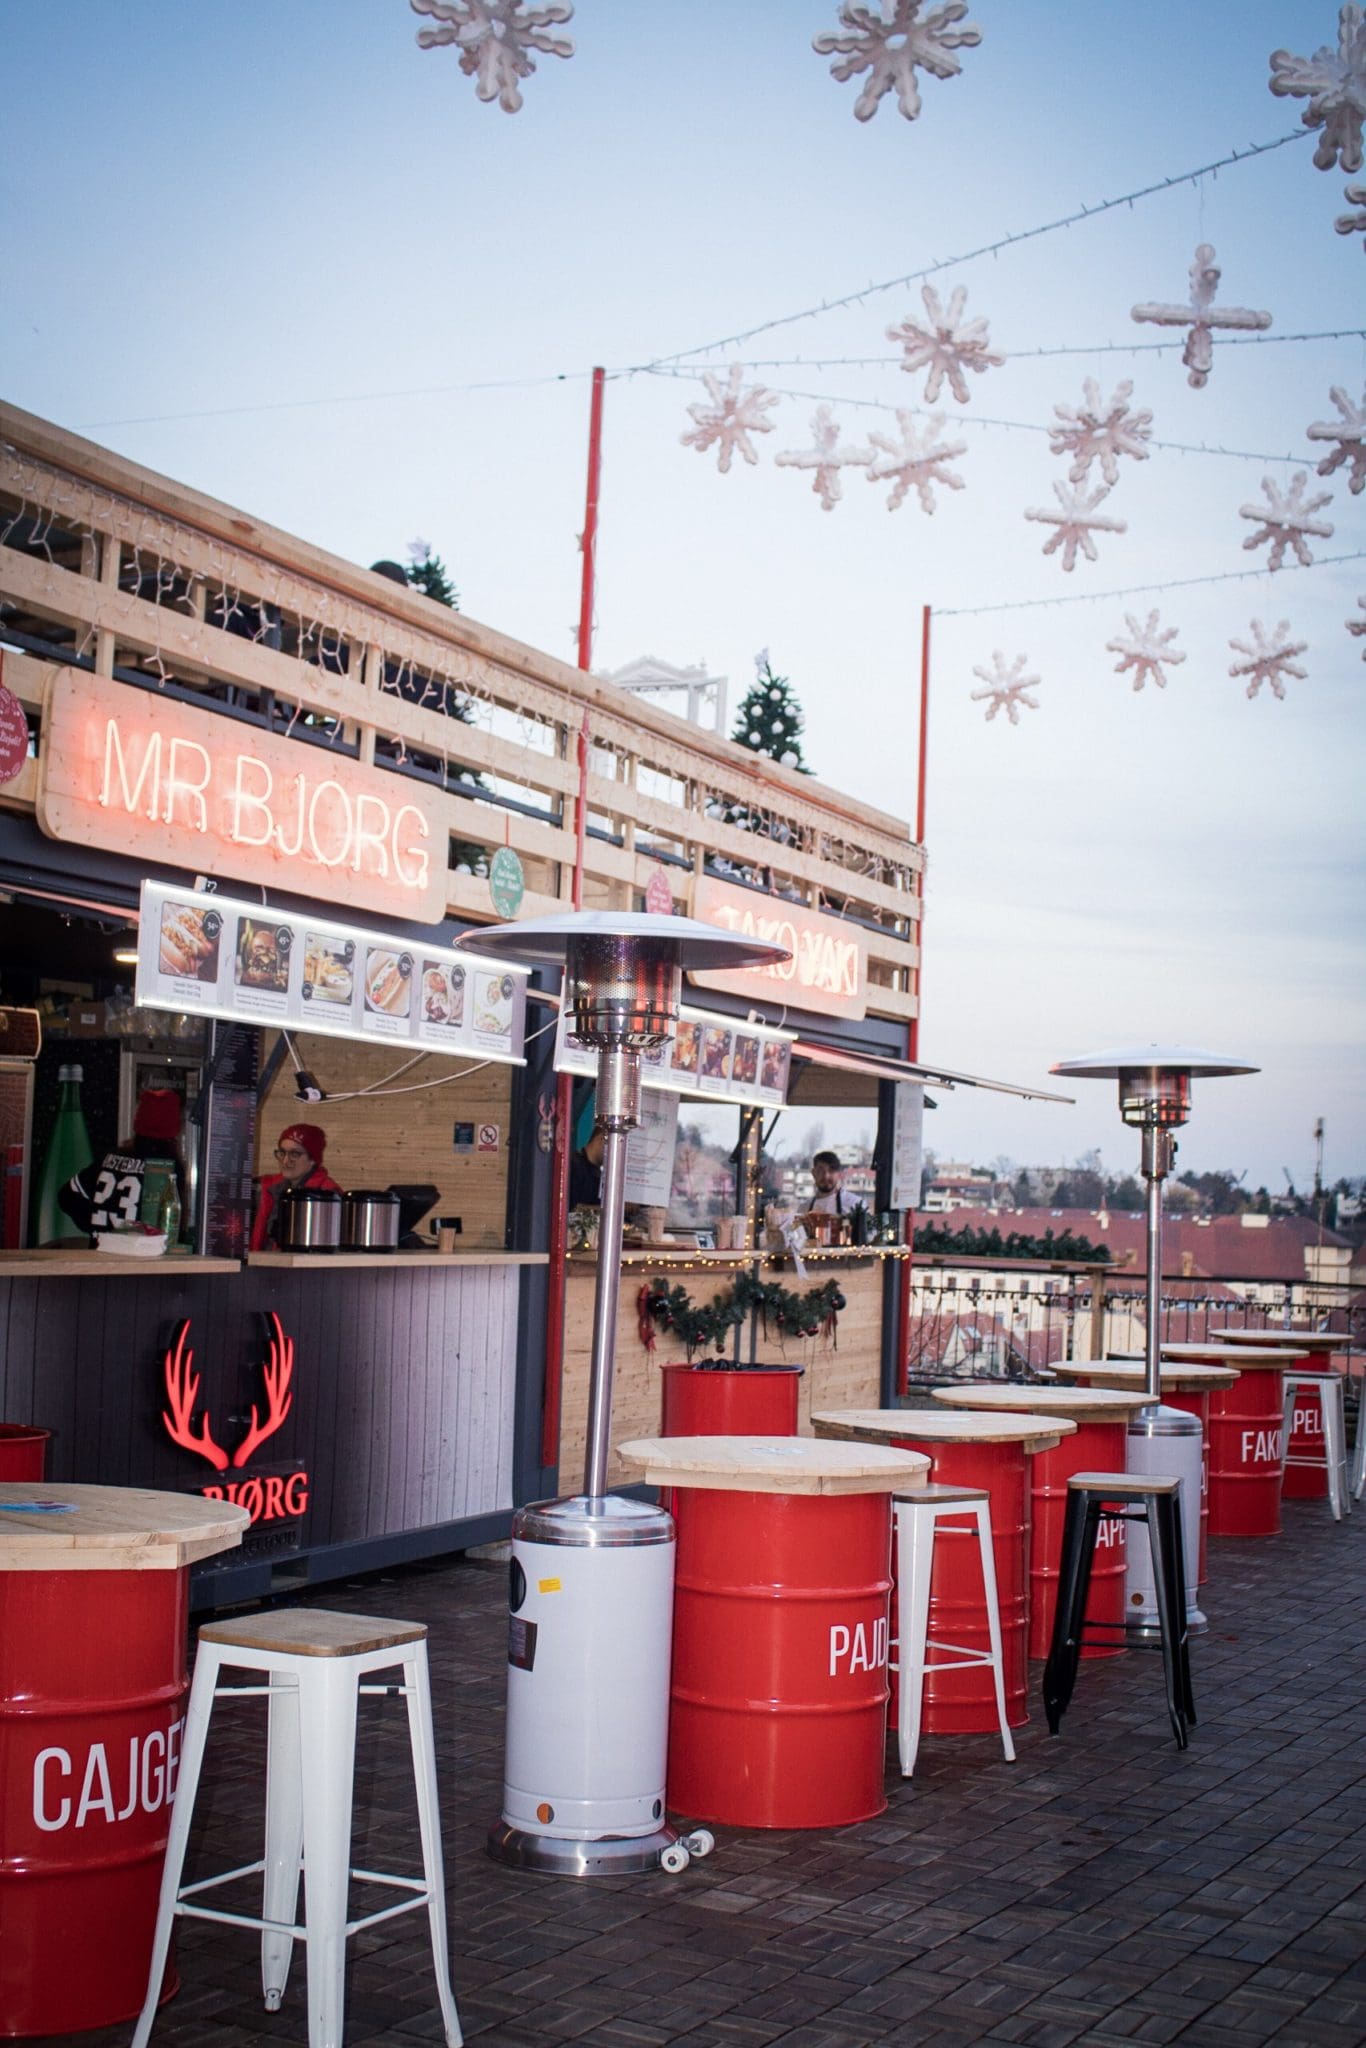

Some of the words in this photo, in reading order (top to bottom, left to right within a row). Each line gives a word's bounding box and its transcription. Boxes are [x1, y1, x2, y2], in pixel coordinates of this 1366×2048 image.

[98, 719, 212, 833] MR
[231, 754, 429, 889] BJORG
[91, 1171, 142, 1228] 23
[1289, 1410, 1322, 1434] PEL
[33, 1715, 186, 1832] CAJGE
